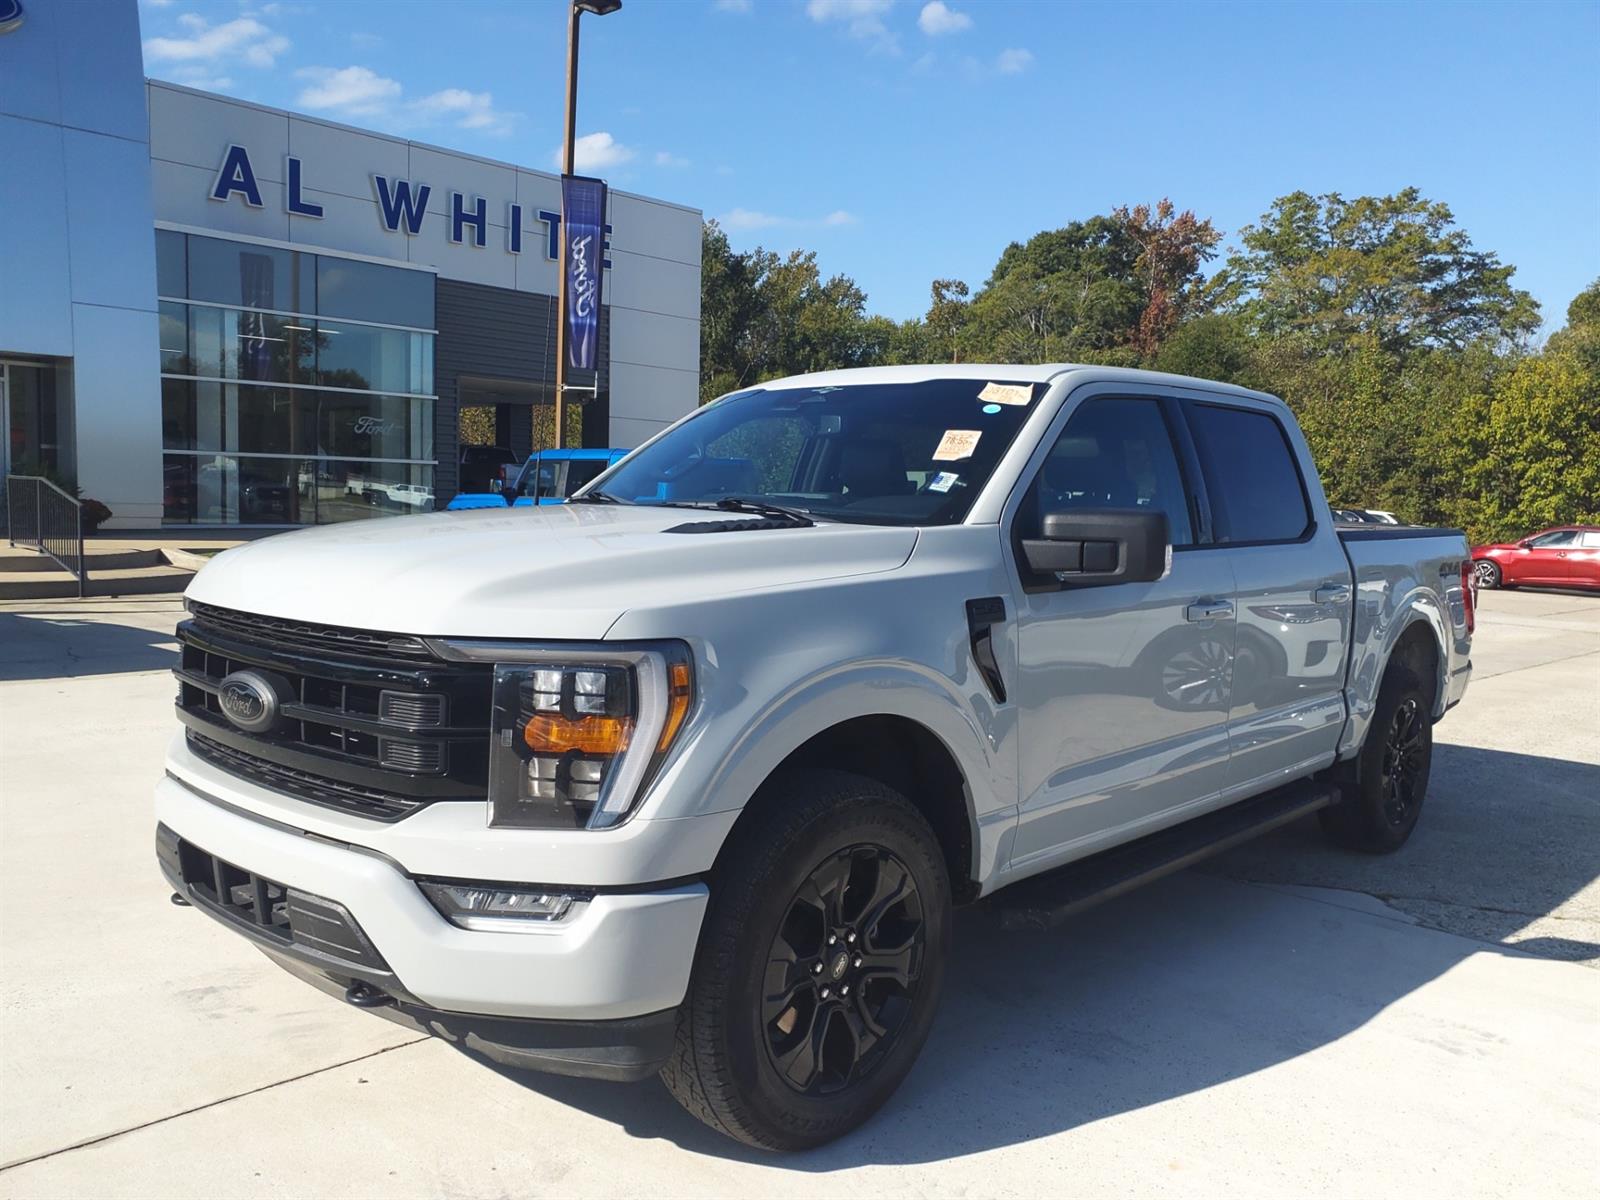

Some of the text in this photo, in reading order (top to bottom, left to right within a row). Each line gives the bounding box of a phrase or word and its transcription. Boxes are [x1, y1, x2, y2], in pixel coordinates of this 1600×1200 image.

[210, 144, 324, 218] AL
[353, 416, 395, 435] Ford
[225, 687, 253, 715] Ford
